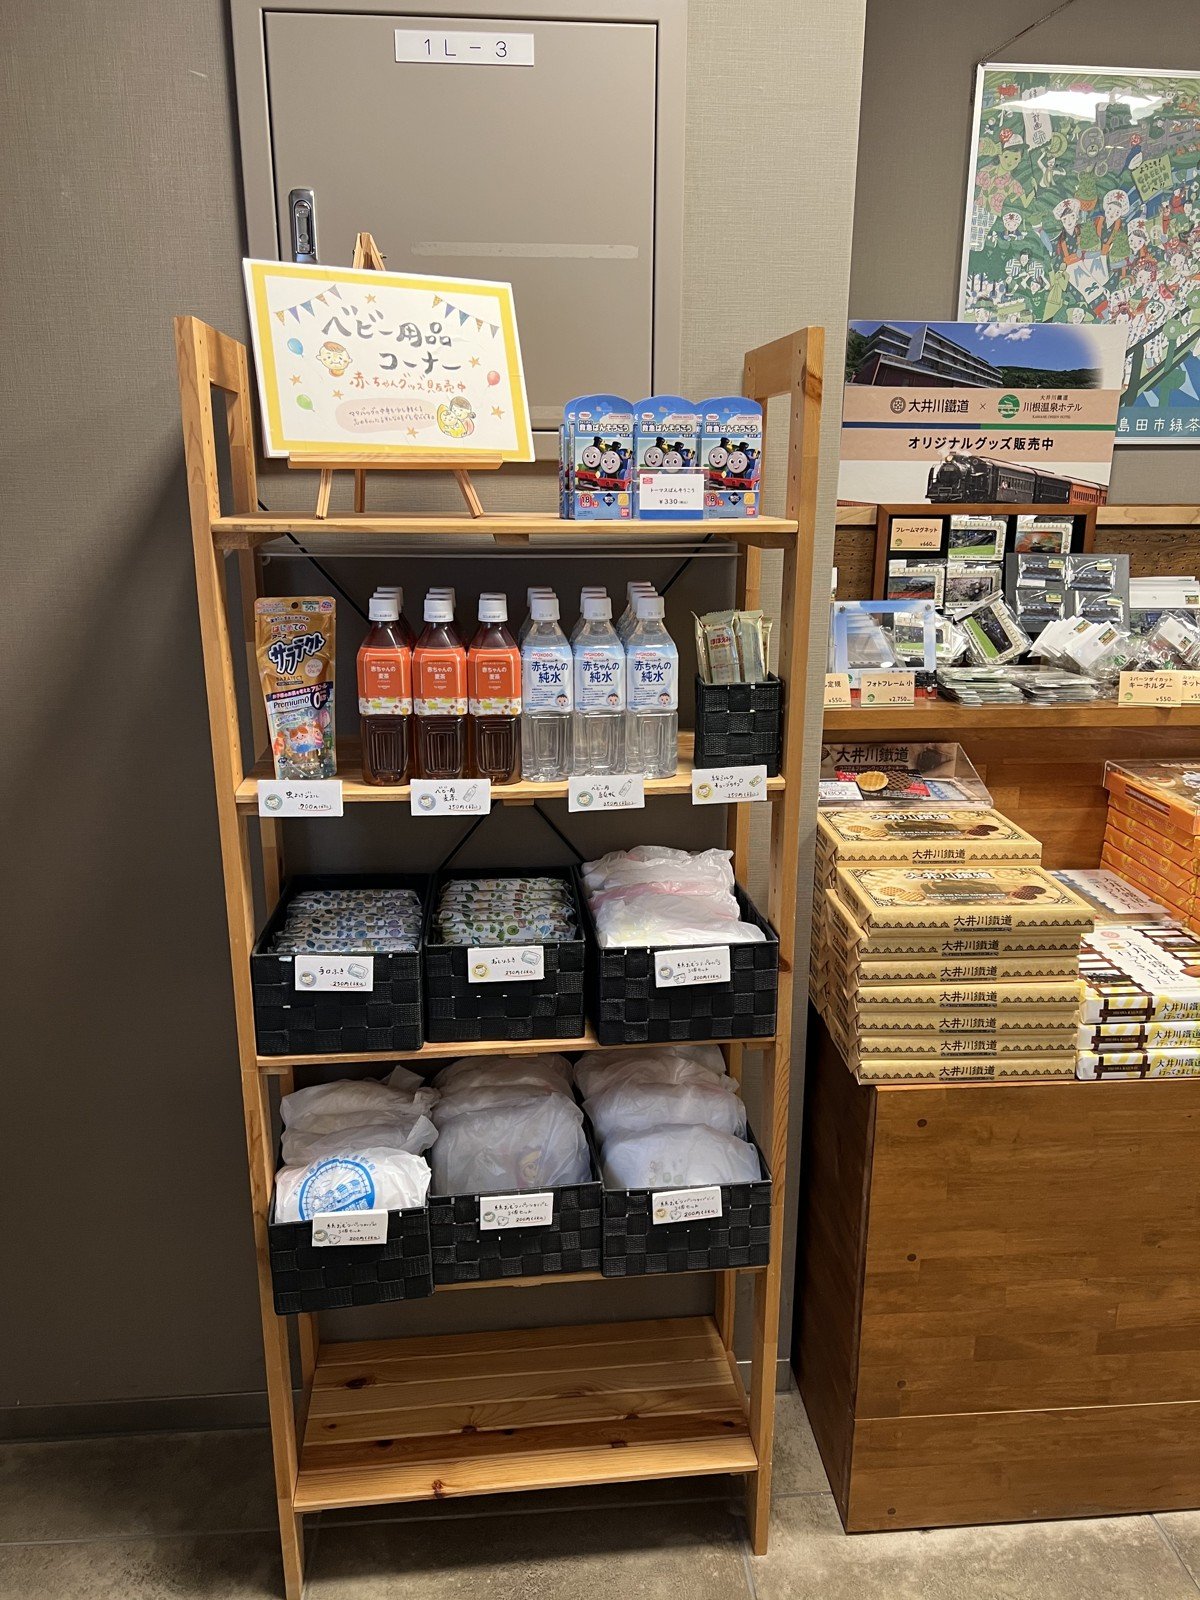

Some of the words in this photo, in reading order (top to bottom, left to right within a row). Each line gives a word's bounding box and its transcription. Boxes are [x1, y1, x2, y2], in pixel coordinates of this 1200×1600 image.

[321, 304, 452, 348] ベビー用品
[379, 351, 461, 374] コーナー
[349, 371, 466, 394] 赤ちゃんグッズ販売中
[908, 398, 969, 414] 大井川鐵道
[1023, 402, 1082, 413] 川根温泉ホテル
[578, 423, 629, 433] 救急ばんそうこう
[641, 423, 693, 433] 救急ばんそうこう
[705, 424, 758, 434] 救急ばんそうこう
[908, 437, 1054, 451] オリジナルグッズ販売中
[272, 623, 307, 632] はじめての
[268, 631, 326, 675] サラテクト
[532, 661, 568, 672] 赤ちゃんの
[582, 661, 619, 672] 赤ちゃんの
[634, 661, 671, 672] 赤ちゃんの
[539, 671, 561, 683] 純水
[589, 671, 612, 683] 純水
[641, 671, 664, 683] 純水
[836, 747, 910, 763] 大井川鐵道
[912, 848, 966, 860] 大井川鐵道
[953, 915, 1012, 927] 大井川鐵道
[942, 940, 999, 951] 大井川鐵道
[940, 966, 997, 977] 大井川鐵道
[939, 991, 997, 1003] 大井川鐵道
[939, 1018, 996, 1029] 大井川鐵道
[940, 1040, 997, 1051] 大井川鐵道
[939, 1066, 995, 1076] 大井川鐵道
